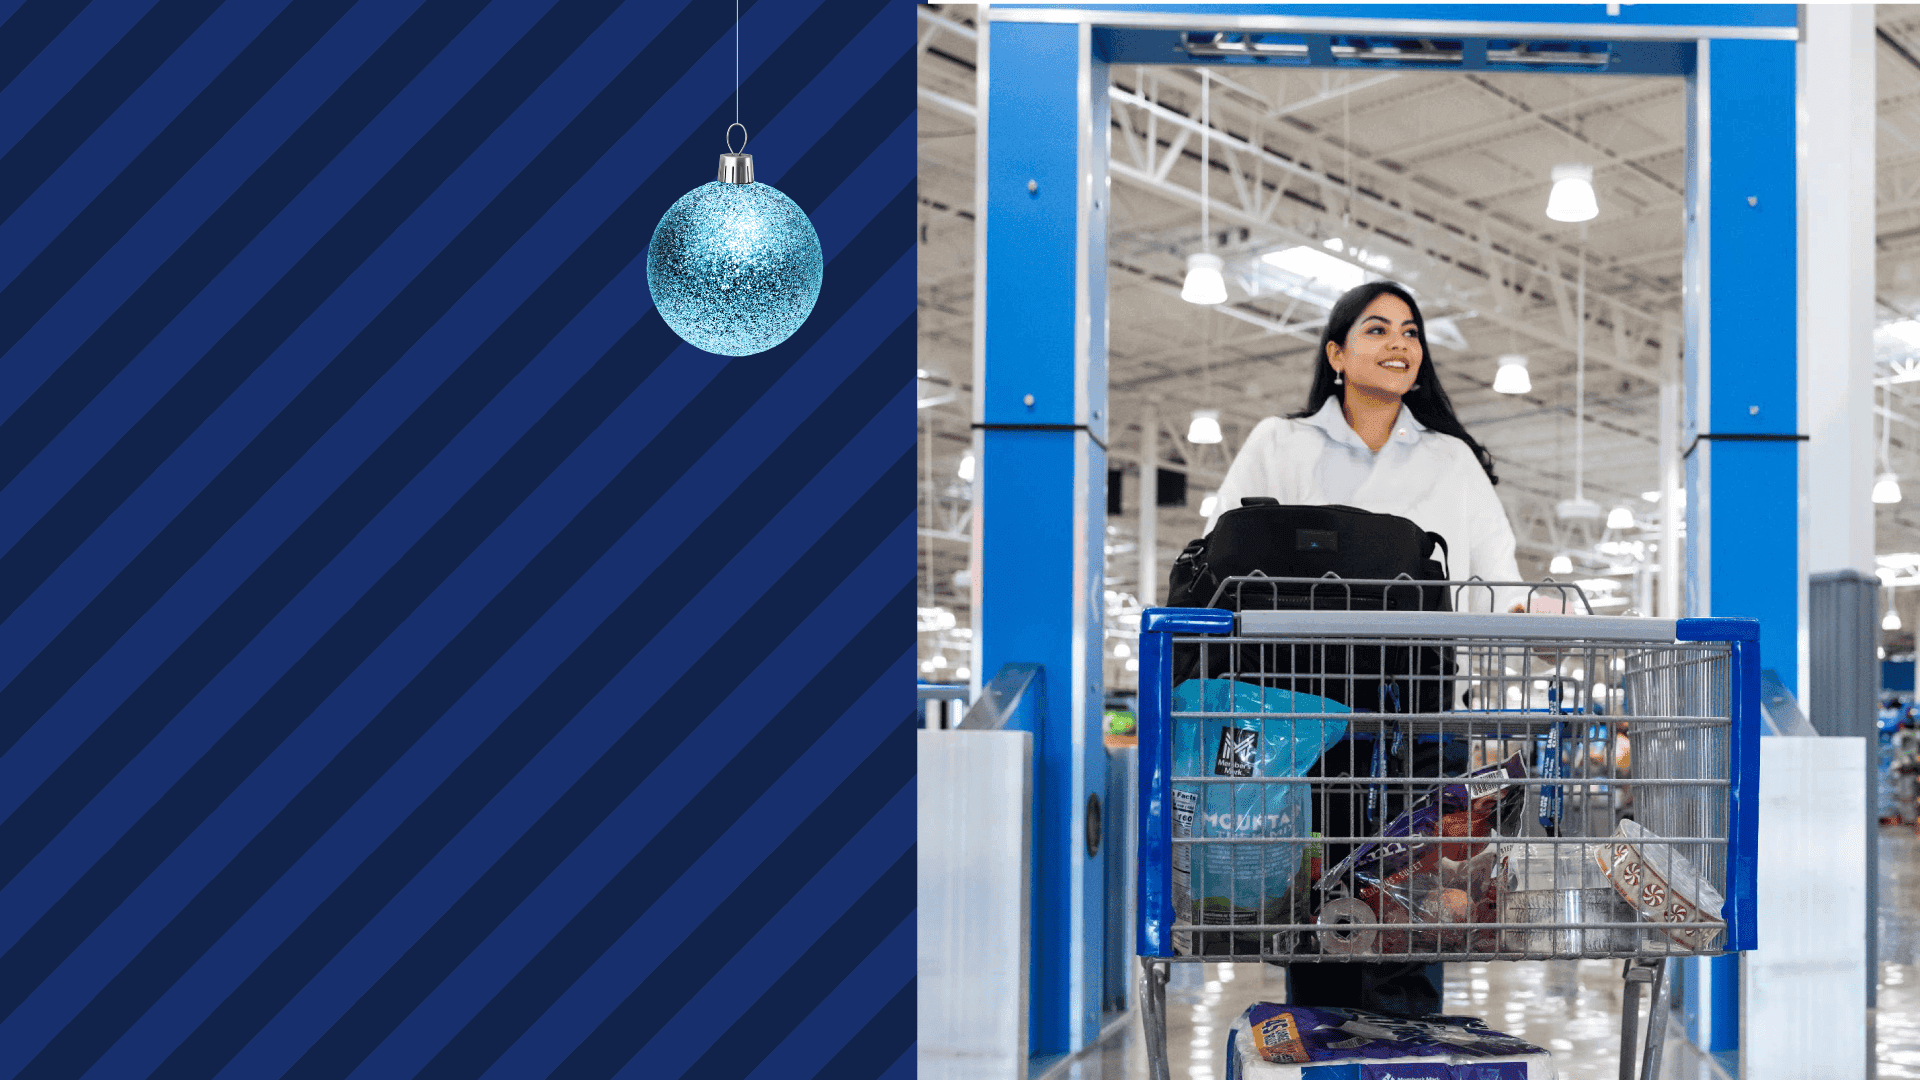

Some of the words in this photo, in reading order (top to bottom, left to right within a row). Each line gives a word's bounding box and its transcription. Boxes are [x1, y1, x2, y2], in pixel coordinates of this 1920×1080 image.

[1224, 767, 1242, 776] Mrk
[1177, 791, 1196, 801] Facts
[1202, 806, 1299, 830] MOUNTA
[1359, 876, 1397, 898] DELICUS
